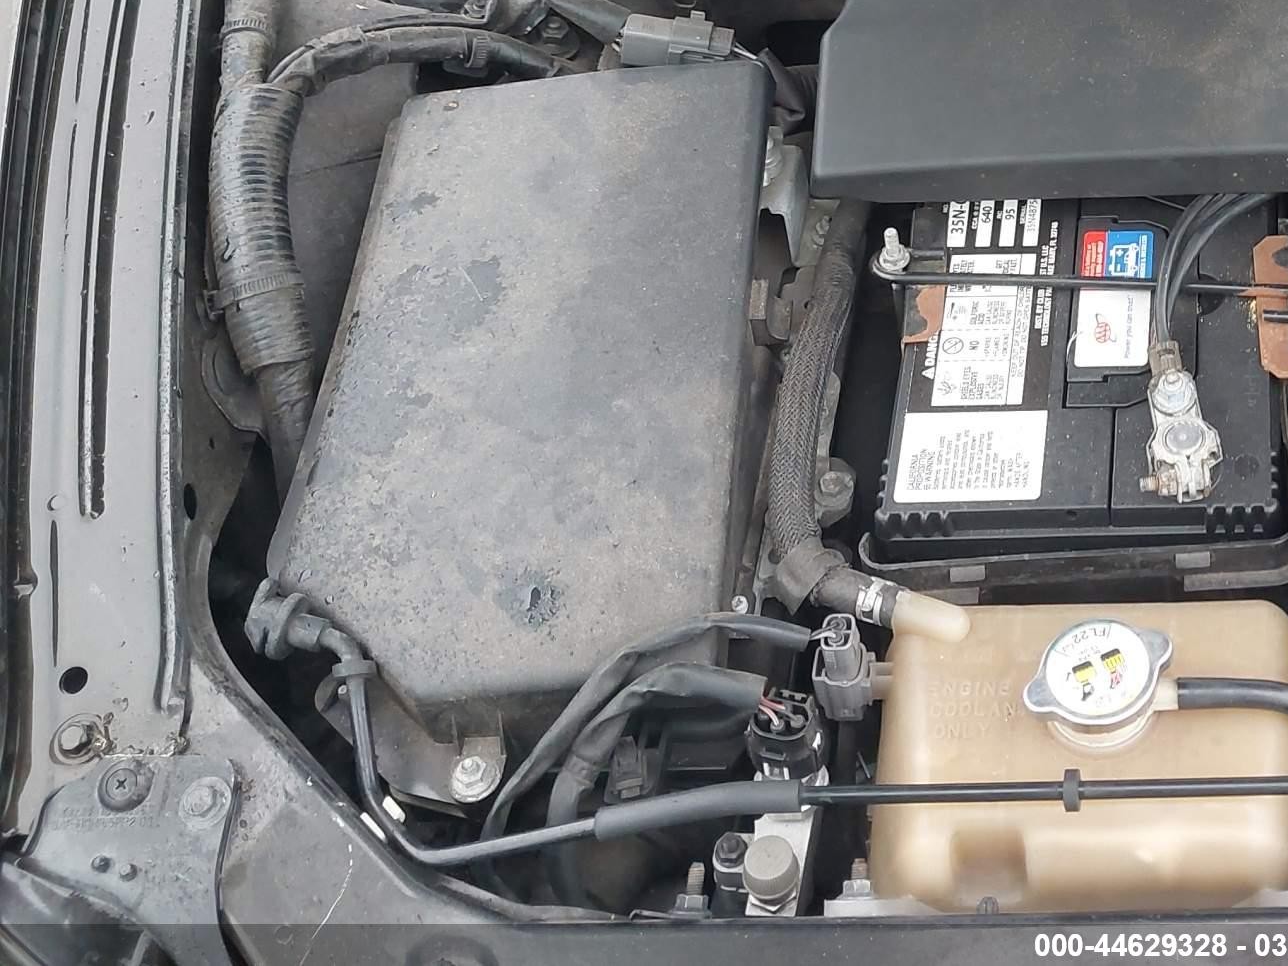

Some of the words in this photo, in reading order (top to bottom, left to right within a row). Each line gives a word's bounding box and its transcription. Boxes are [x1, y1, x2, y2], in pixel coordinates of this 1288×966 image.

[950, 202, 967, 234] 35N-
[981, 206, 992, 224] 640
[1005, 208, 1015, 220] 95
[924, 331, 938, 366] DANG
[969, 340, 979, 351] NO
[928, 679, 1011, 697] ENGINE
[929, 700, 1021, 718] COOLAN
[935, 721, 992, 739] ONLY
